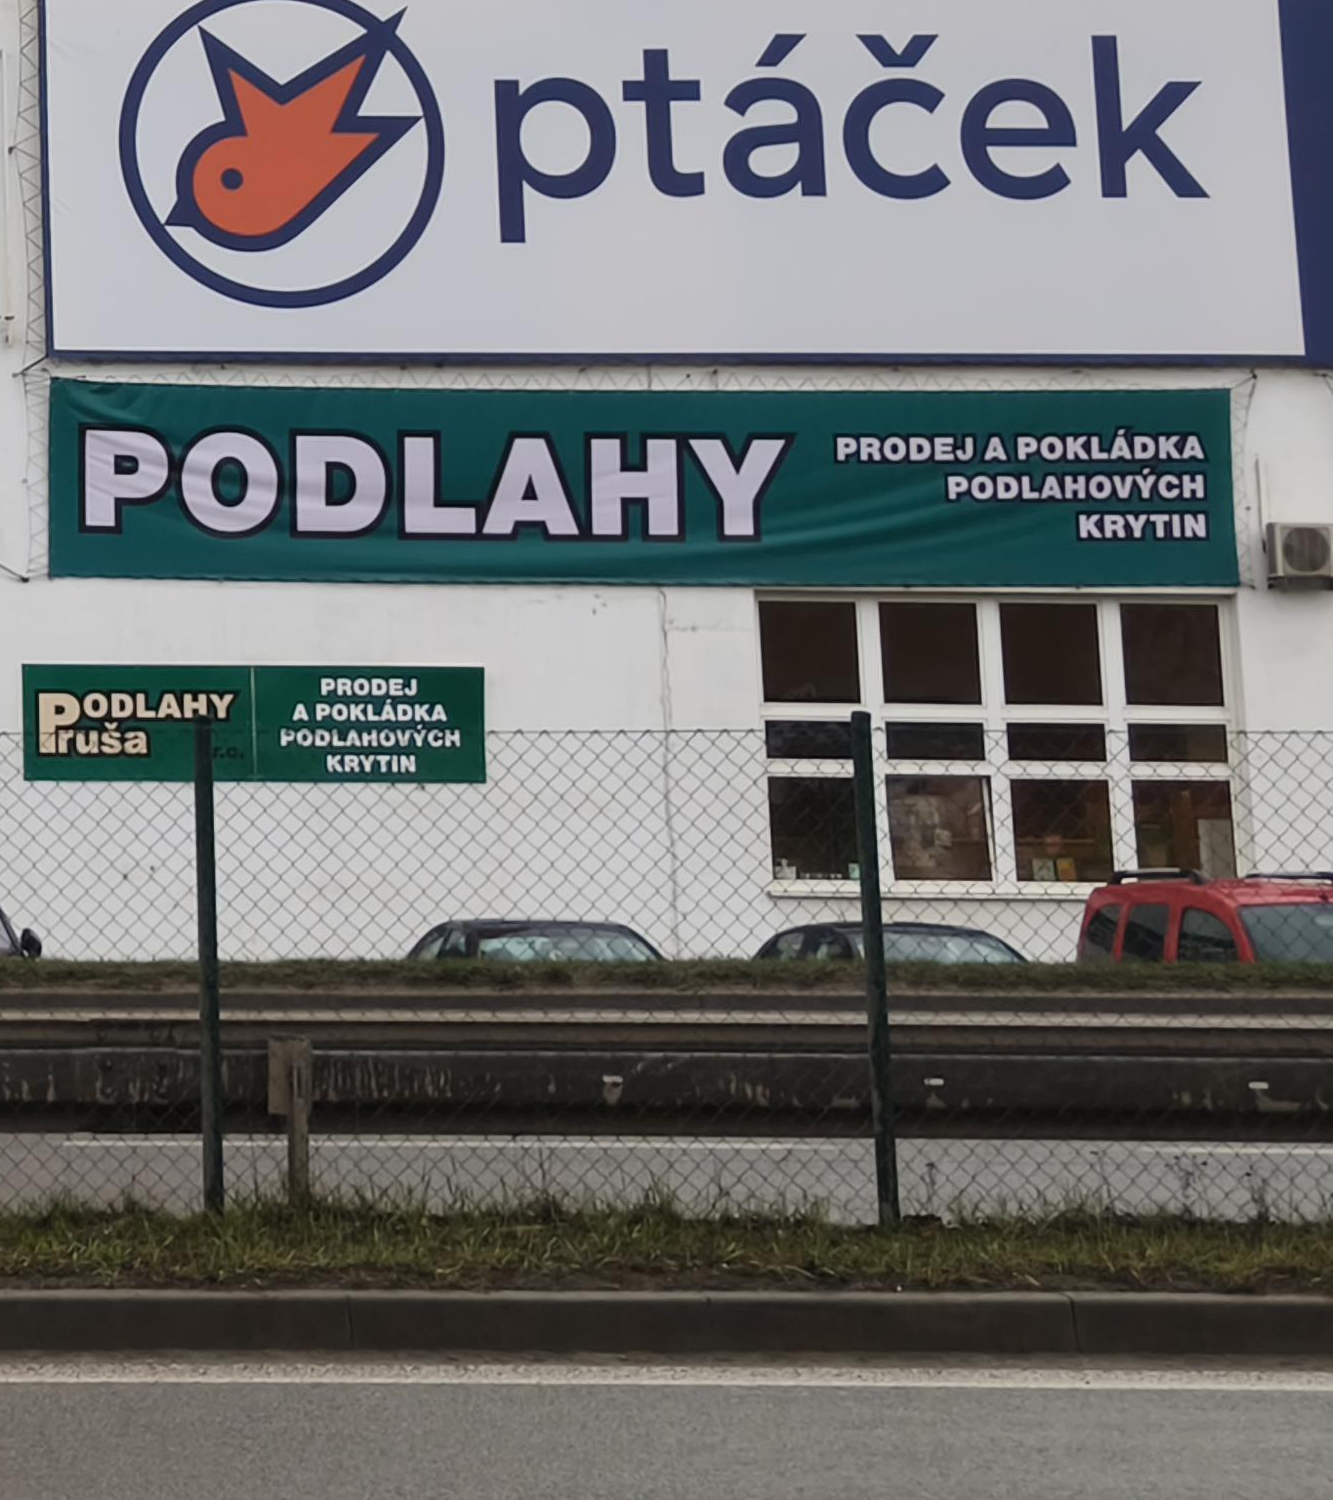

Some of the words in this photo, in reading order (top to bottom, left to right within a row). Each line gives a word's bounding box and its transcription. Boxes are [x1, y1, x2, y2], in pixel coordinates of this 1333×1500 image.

[493, 34, 1211, 244] ptáček
[836, 436, 974, 461] PRODEJ
[984, 436, 1007, 461] A
[1017, 429, 1204, 460] POKLÁDKA
[85, 427, 791, 538] PODLAHY
[948, 468, 1204, 499] PODLAHOVÝCH
[1078, 514, 1206, 538] KRYTIN
[320, 678, 418, 696] PRODEJ
[292, 703, 309, 721] A
[315, 699, 447, 722] POKLÁDKA
[280, 724, 461, 747] PODLAHOVÝCH
[326, 754, 416, 773] KRYTIN
